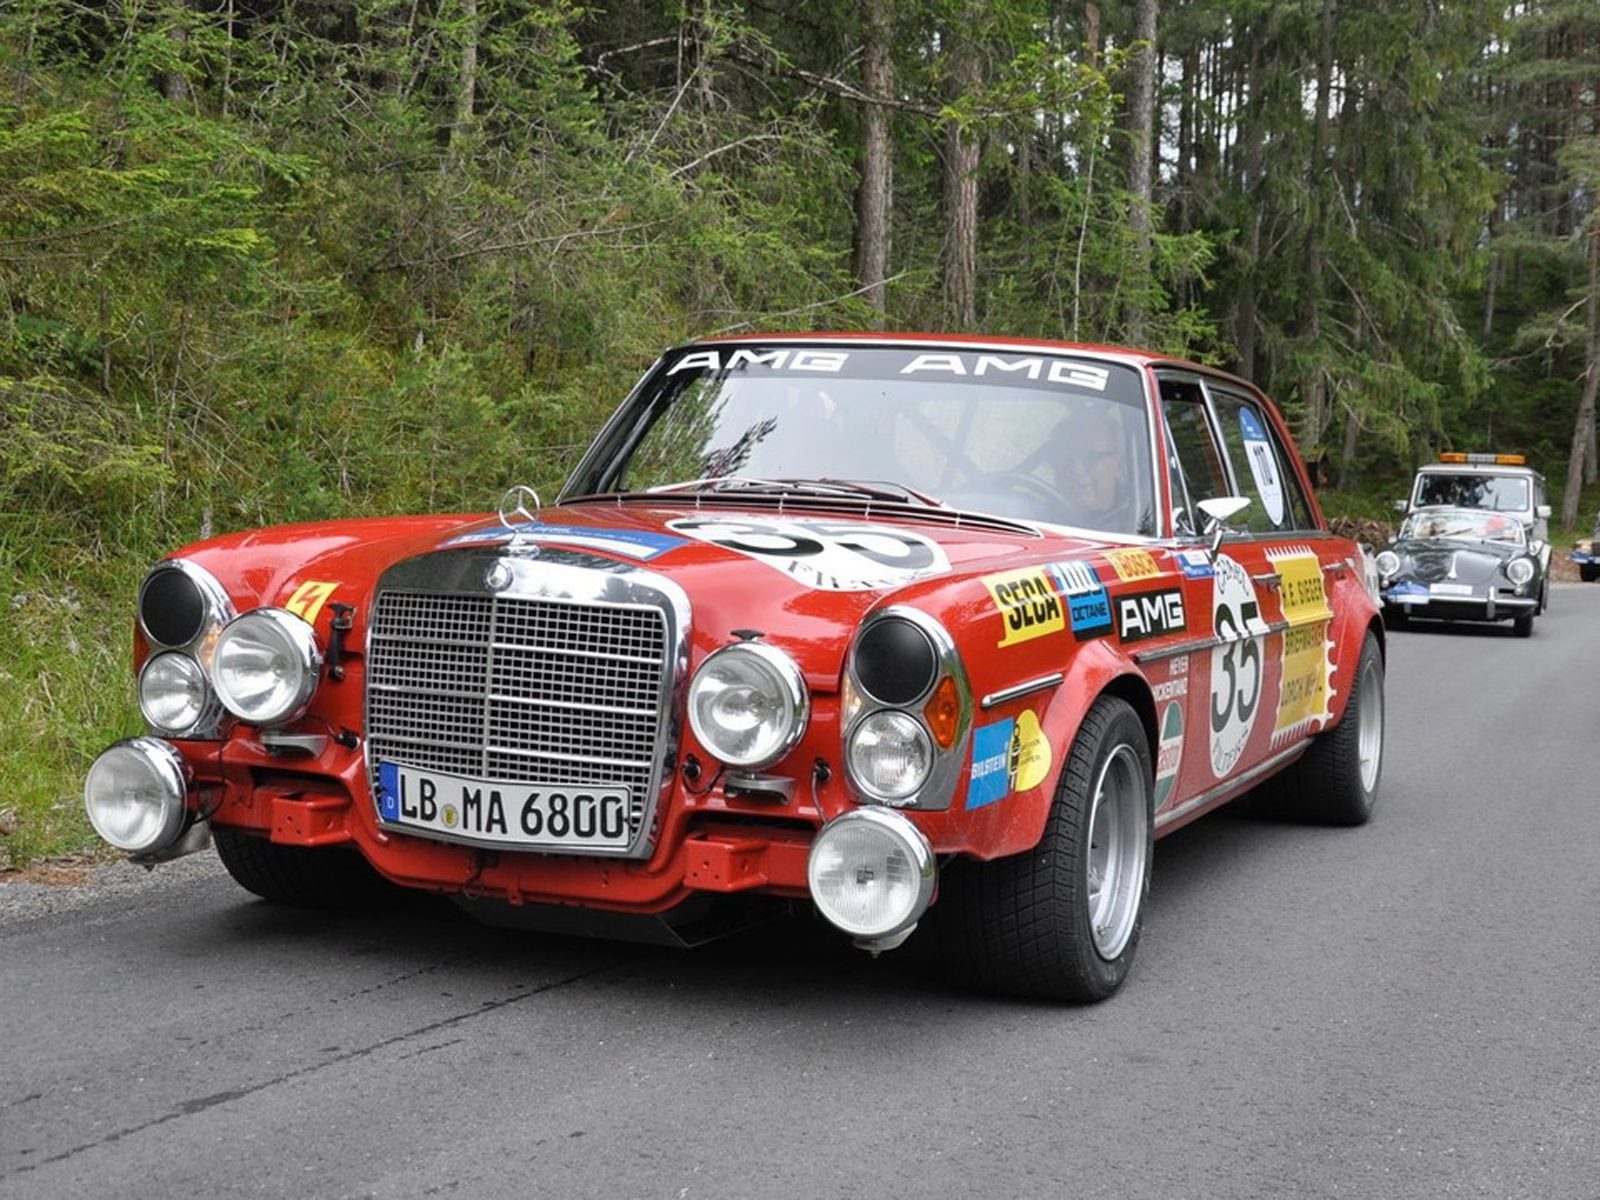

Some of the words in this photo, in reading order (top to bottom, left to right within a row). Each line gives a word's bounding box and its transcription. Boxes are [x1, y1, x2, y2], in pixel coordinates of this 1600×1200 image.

[667, 350, 849, 376] AMG
[900, 354, 1109, 391] AMG
[672, 521, 935, 569] 35
[1121, 552, 1158, 578] BOSCH
[1072, 602, 1107, 622] OCTANE
[1121, 593, 1185, 638] AMG
[1211, 601, 1259, 733] 35
[400, 775, 437, 822] LB
[462, 786, 508, 835] MA
[520, 792, 624, 839] 6800
